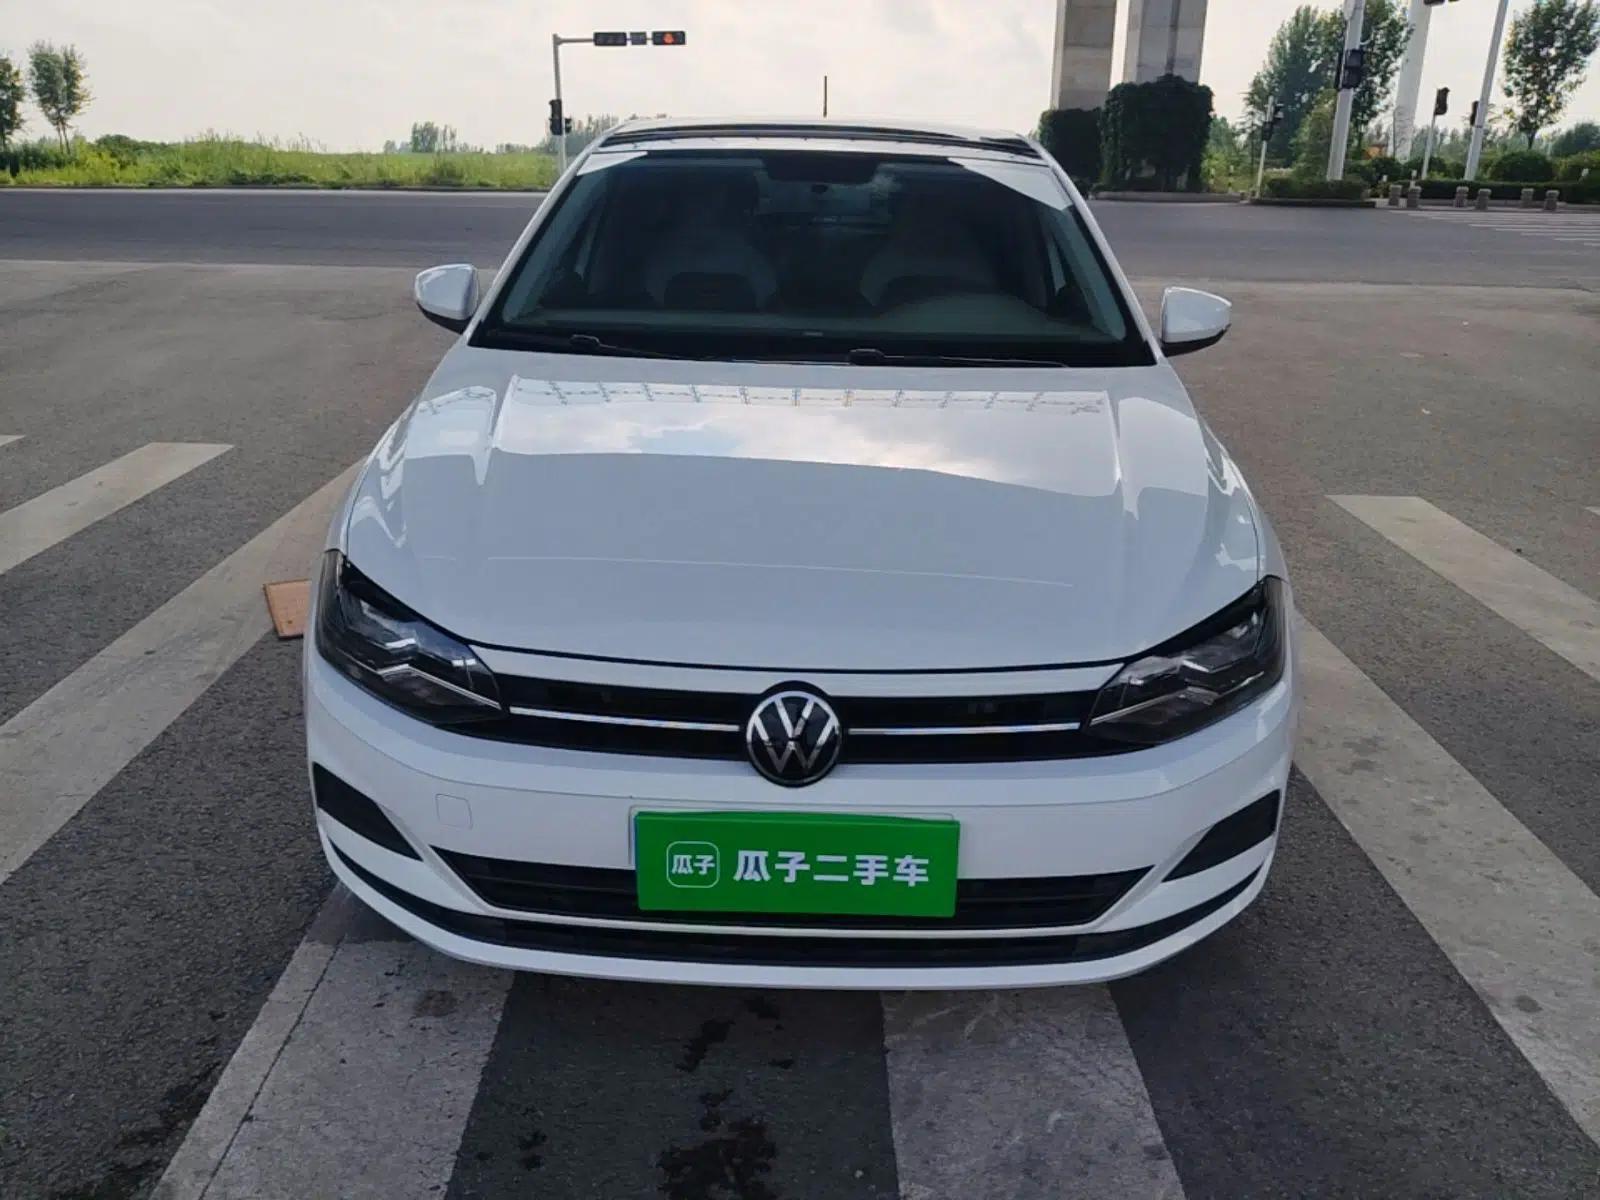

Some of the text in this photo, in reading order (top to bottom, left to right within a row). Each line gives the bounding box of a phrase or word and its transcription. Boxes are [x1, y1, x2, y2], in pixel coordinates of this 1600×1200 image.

[671, 854, 715, 875] 瓜子
[733, 850, 929, 887] 瓜子二手车
